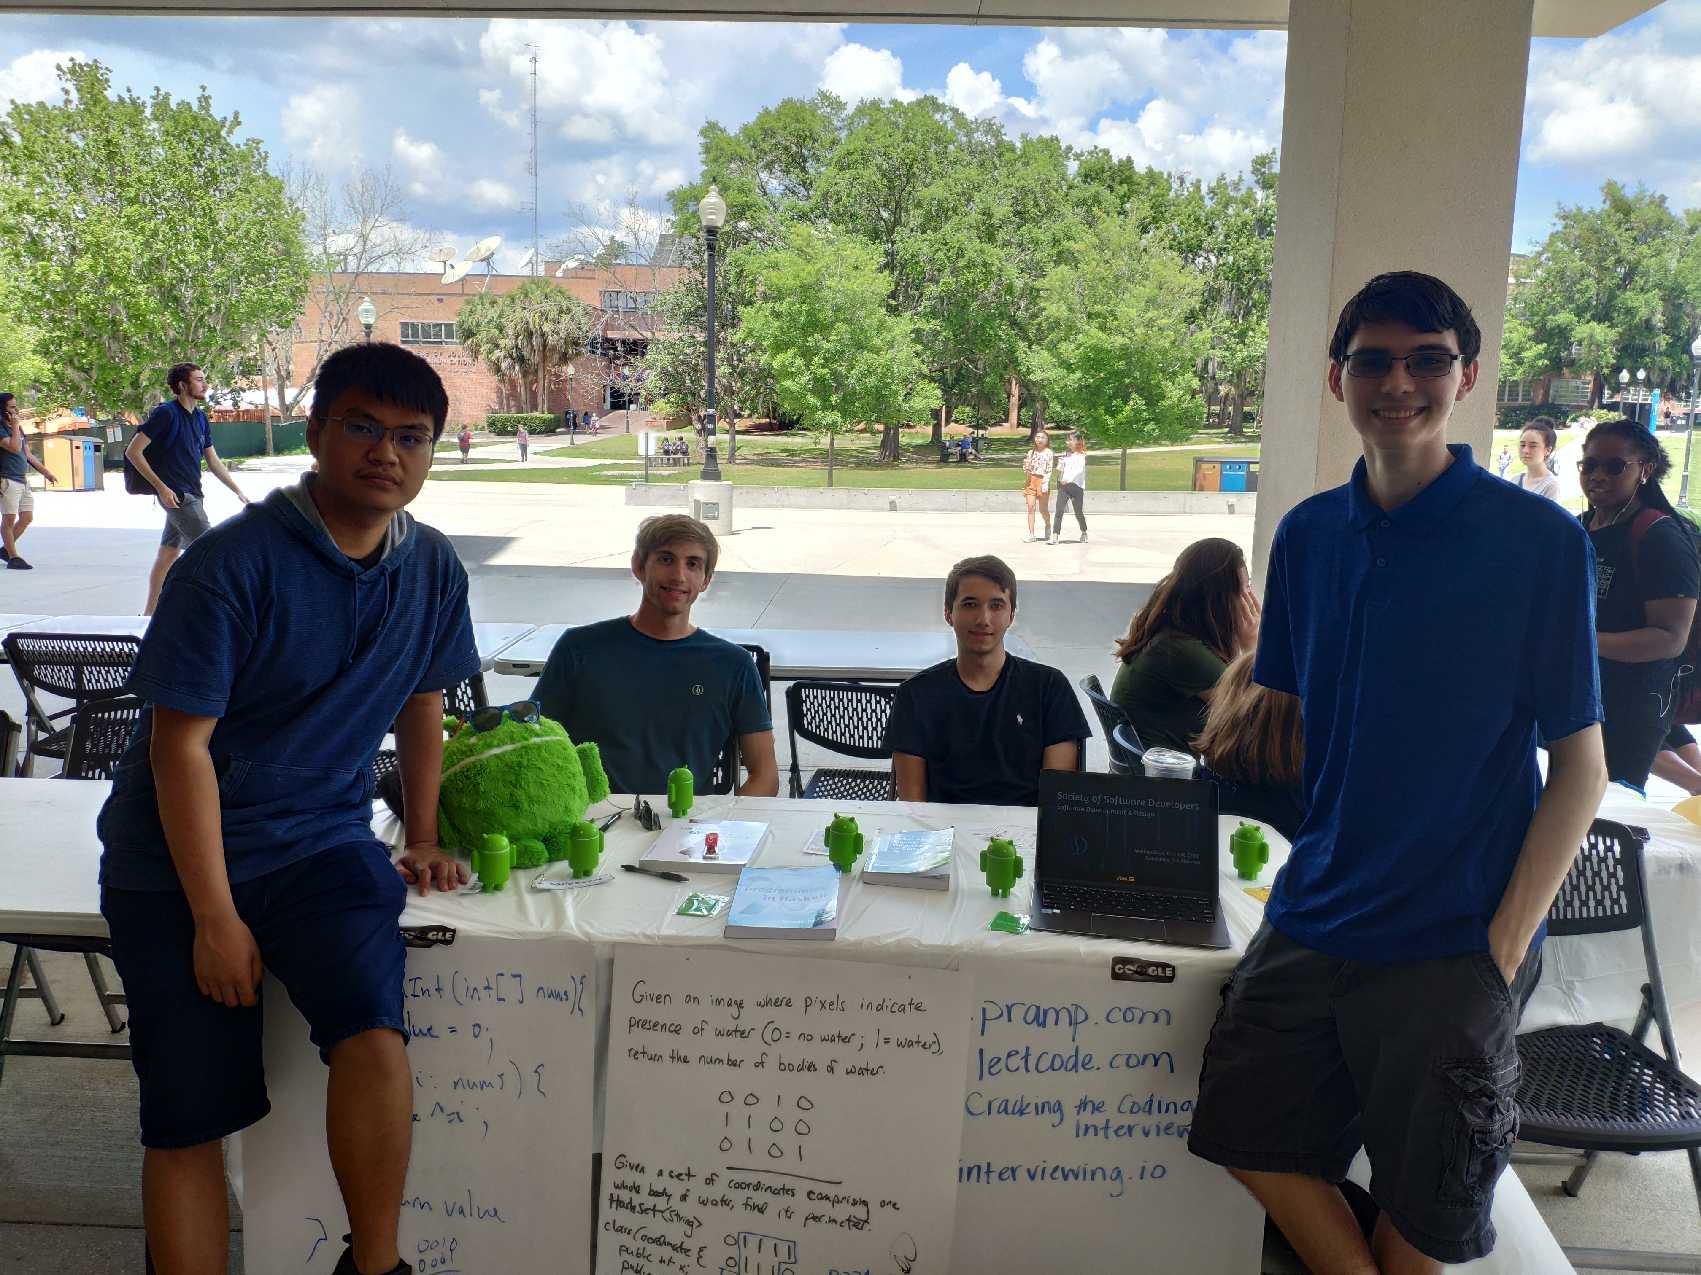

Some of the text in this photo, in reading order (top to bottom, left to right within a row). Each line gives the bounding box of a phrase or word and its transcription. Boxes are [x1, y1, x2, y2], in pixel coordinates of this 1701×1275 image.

[1057, 791, 1200, 812] Society of Software Developers
[632, 980, 928, 1020] Given an image where pixels indicate
[628, 1015, 682, 1036] presence
[692, 1019, 708, 1036] of
[714, 1023, 757, 1039] water
[797, 1031, 814, 1043] no
[979, 1000, 1173, 1043] pramp.com
[627, 1047, 664, 1064] return
[669, 1047, 690, 1064] the
[698, 1050, 745, 1069] number
[753, 1052, 769, 1069] of
[778, 1056, 819, 1074] bodies
[826, 1059, 839, 1076] of
[977, 1045, 1175, 1081] leetcode.com
[964, 1091, 1064, 1128] Cracking
[1074, 1094, 1106, 1117] the
[614, 1153, 646, 1175] Given
[668, 1166, 696, 1182] set
[704, 1172, 719, 1187] of
[727, 1179, 796, 1199] coordinates
[806, 1189, 871, 1224] comprising
[879, 1200, 901, 1211] one
[957, 1160, 1168, 1198] interviewing.io
[444, 1188, 507, 1224] value
[613, 1180, 642, 1195] whole
[647, 1184, 674, 1206] body
[679, 1187, 691, 1203] of
[741, 1195, 769, 1216] find
